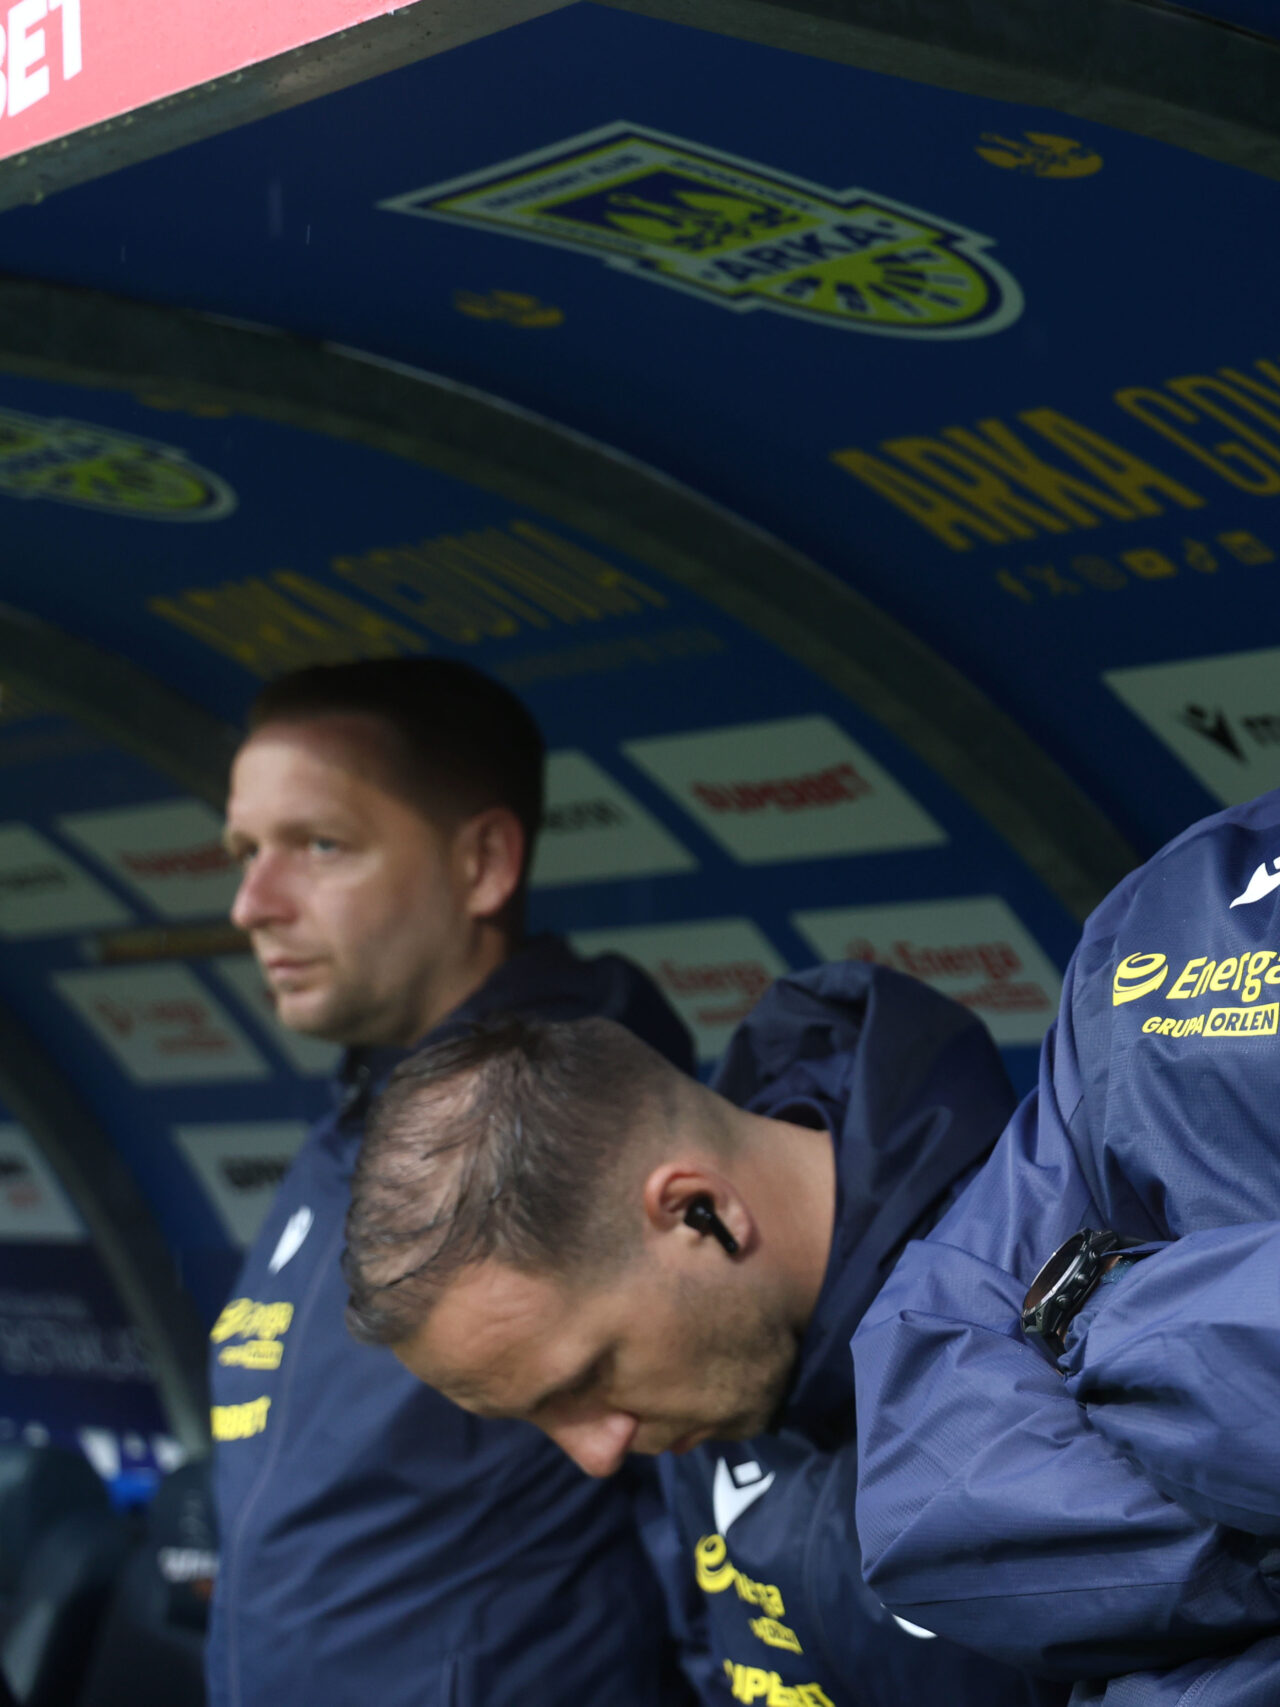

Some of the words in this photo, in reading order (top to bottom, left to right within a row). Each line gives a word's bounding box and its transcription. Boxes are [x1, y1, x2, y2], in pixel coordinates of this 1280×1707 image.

[0, 0, 82, 117] ET
[713, 221, 899, 281] ARKA
[829, 406, 1206, 552] ARKA
[1141, 1014, 1205, 1038] GRUPA
[1210, 1006, 1275, 1031] ORLEN
